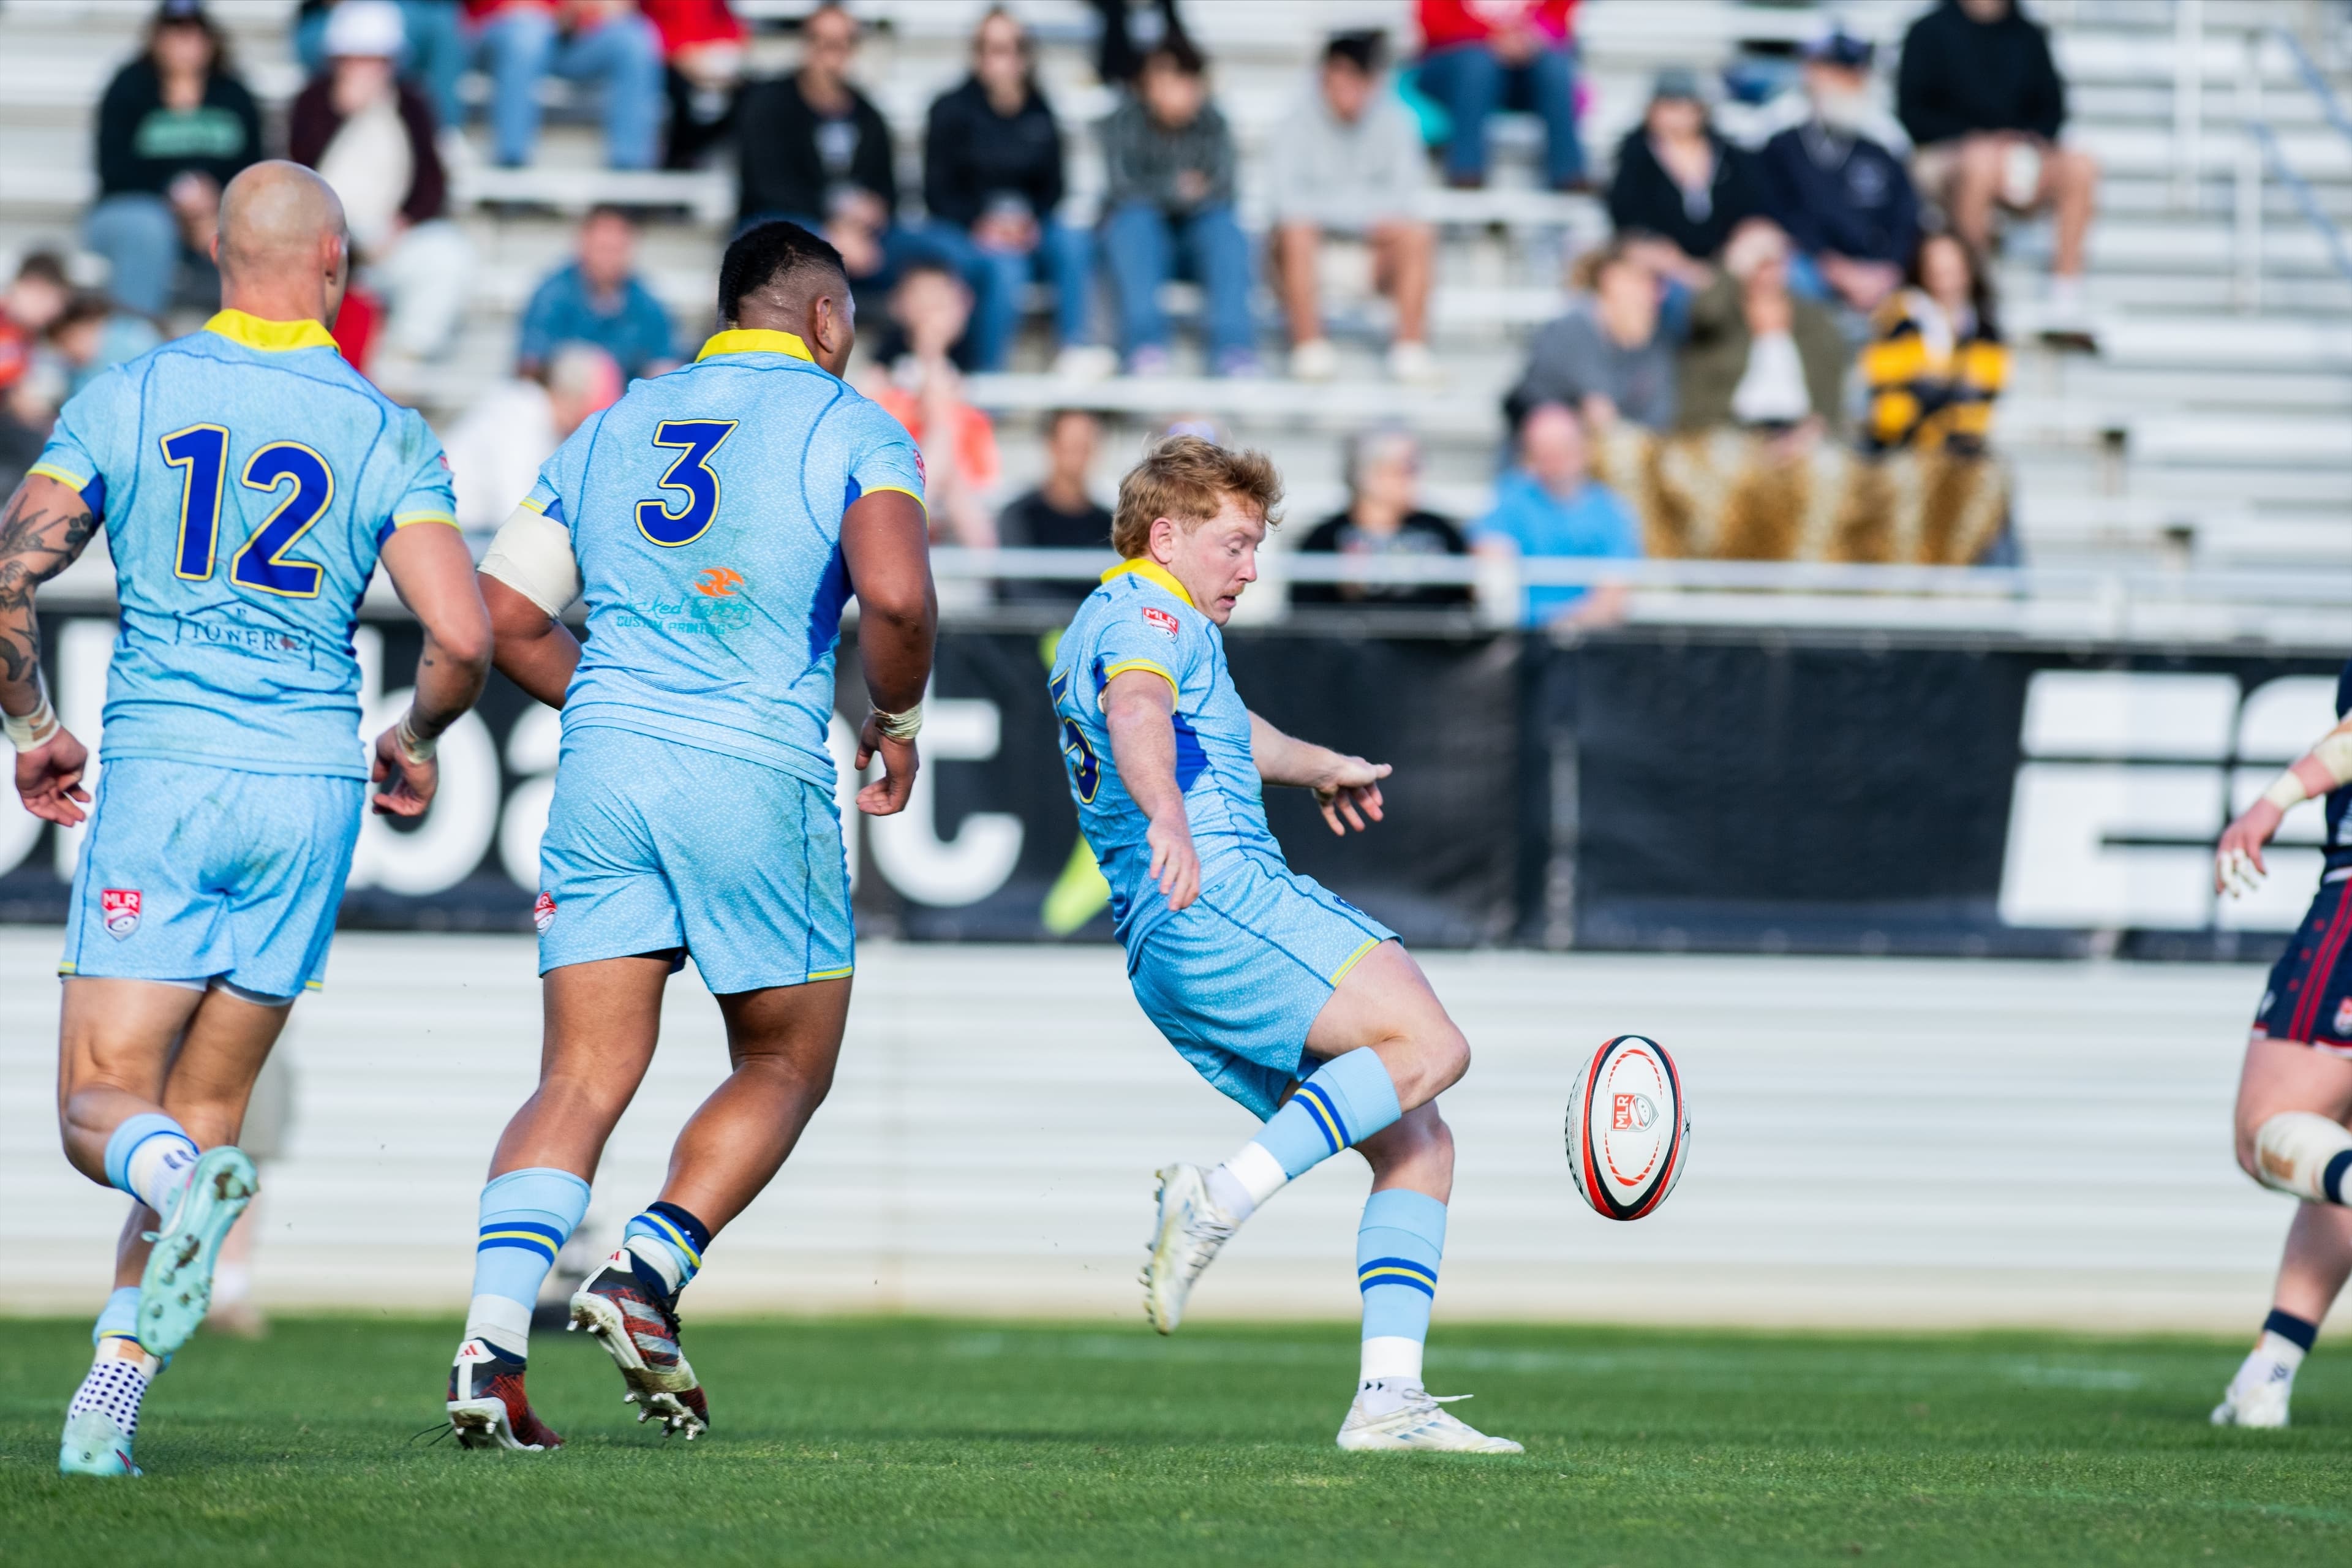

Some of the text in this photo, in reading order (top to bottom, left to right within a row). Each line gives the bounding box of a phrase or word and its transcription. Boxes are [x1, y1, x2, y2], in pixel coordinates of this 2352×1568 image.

[634, 418, 740, 548] 3
[159, 421, 336, 599] 12
[1145, 608, 1177, 628] MLR
[103, 892, 139, 909] MLR
[1615, 1095, 1630, 1128] MLR
